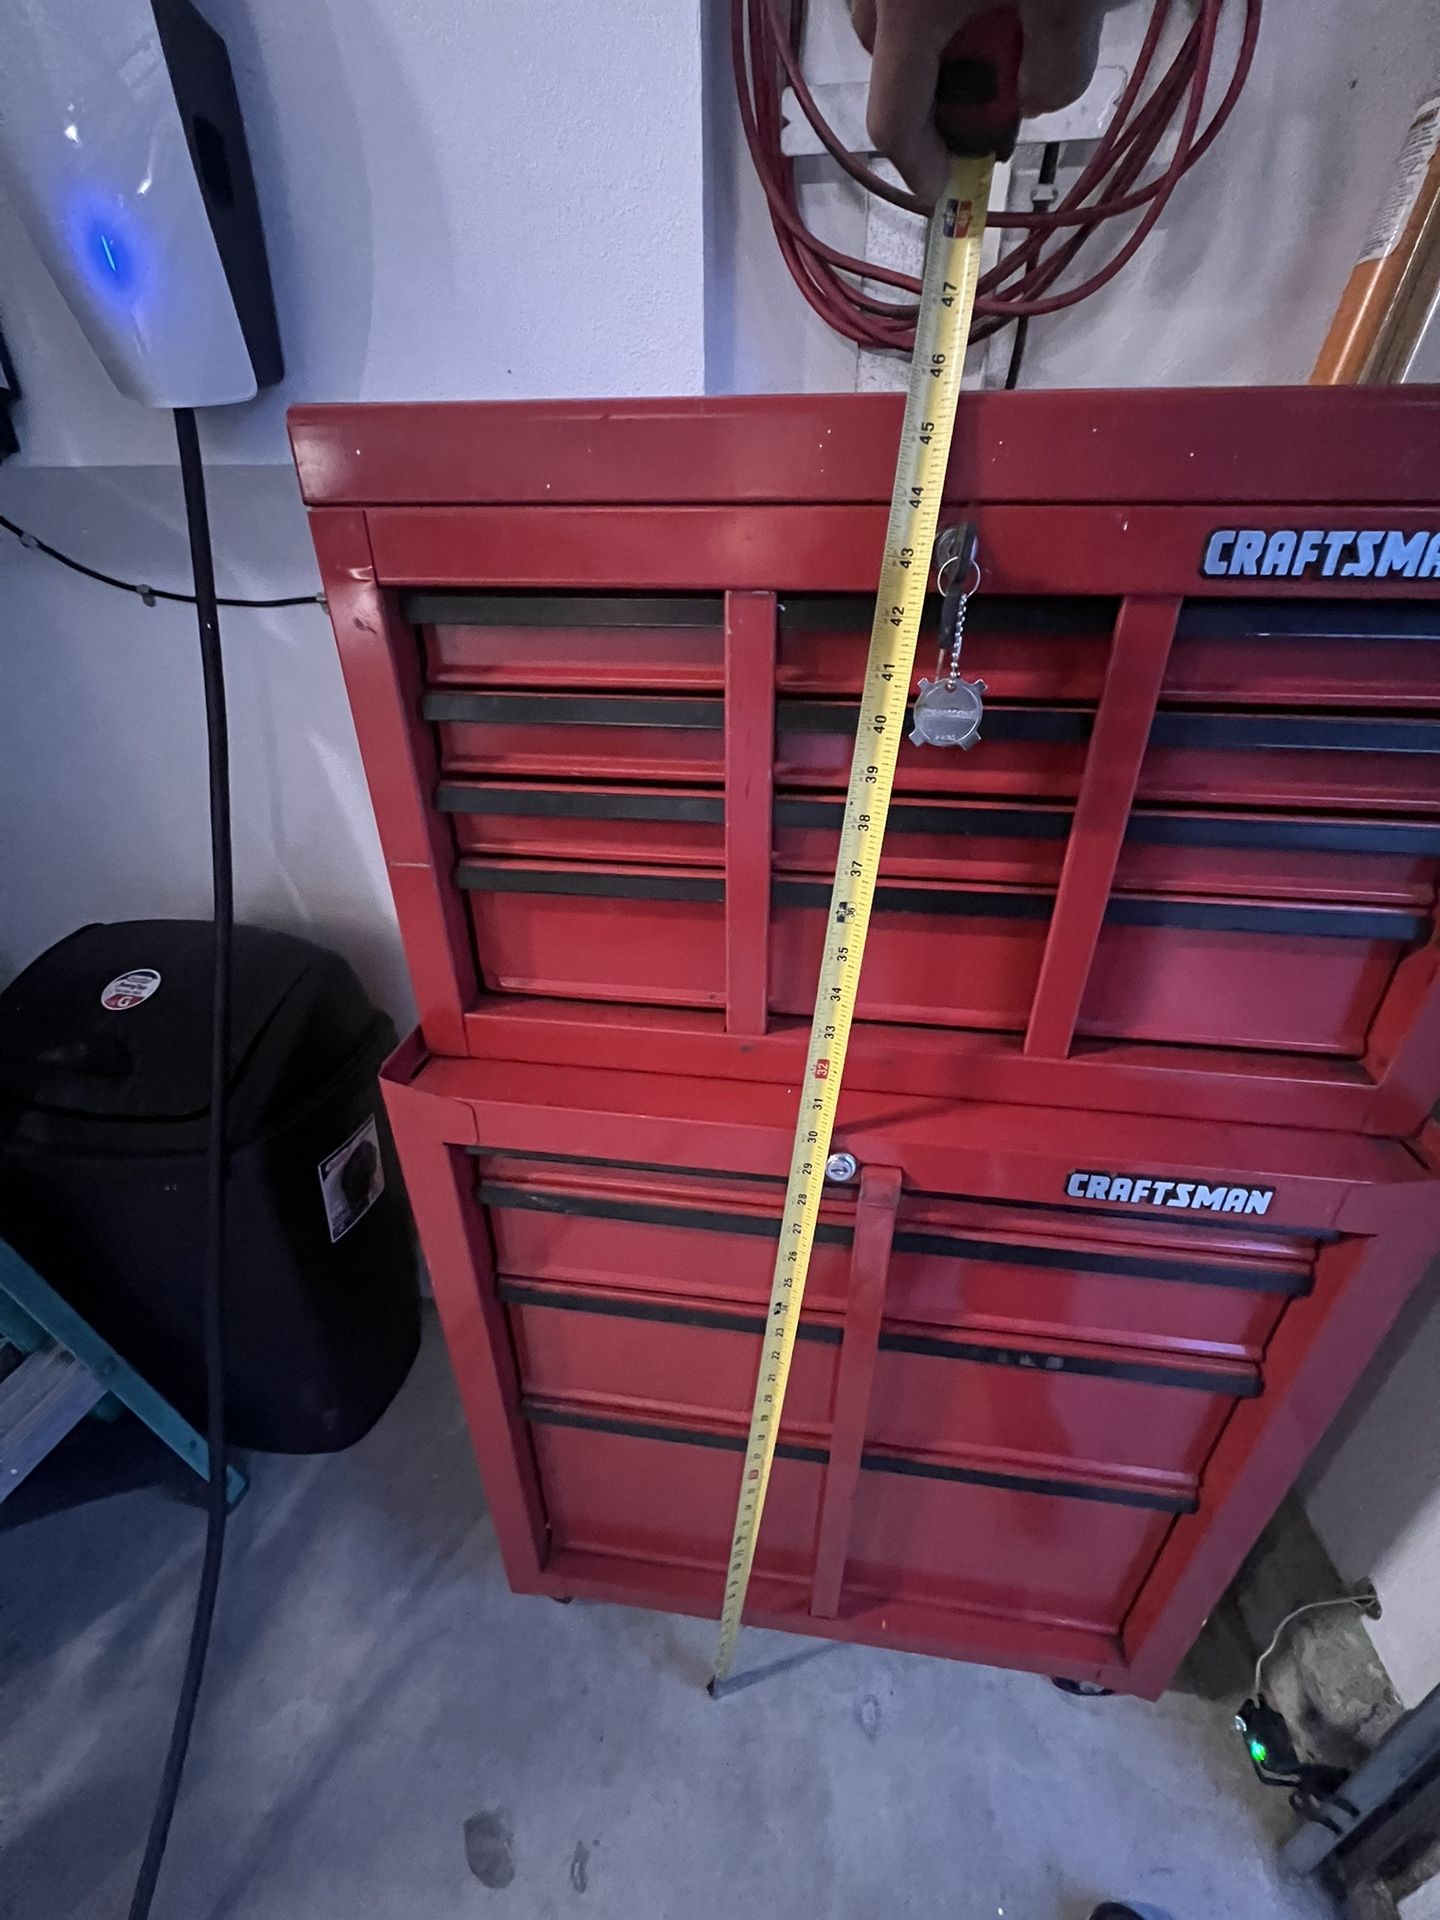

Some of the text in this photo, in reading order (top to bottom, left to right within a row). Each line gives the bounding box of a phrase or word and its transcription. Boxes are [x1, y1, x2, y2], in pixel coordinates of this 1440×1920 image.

[941, 281, 957, 307] 47
[930, 353, 946, 378] 46
[919, 421, 934, 445] 45
[909, 486, 924, 509] 44
[900, 548, 914, 569] 43
[890, 606, 905, 627] 42
[882, 663, 895, 681] 41
[873, 715, 887, 734] 40
[865, 765, 879, 784] 39
[857, 814, 871, 832] 38
[850, 860, 863, 877] 37
[836, 947, 849, 962] 35
[830, 987, 842, 1002] 34
[824, 1025, 836, 1039] 33
[816, 1062, 828, 1076] 32
[812, 1098, 824, 1110] 31
[807, 1130, 818, 1143] 30
[802, 1162, 813, 1175] 29
[797, 1193, 807, 1206] 28
[1066, 1173, 1273, 1215] CRAFTSMAN
[792, 1223, 802, 1234] 27
[787, 1250, 797, 1262] 26
[783, 1277, 793, 1288] 25
